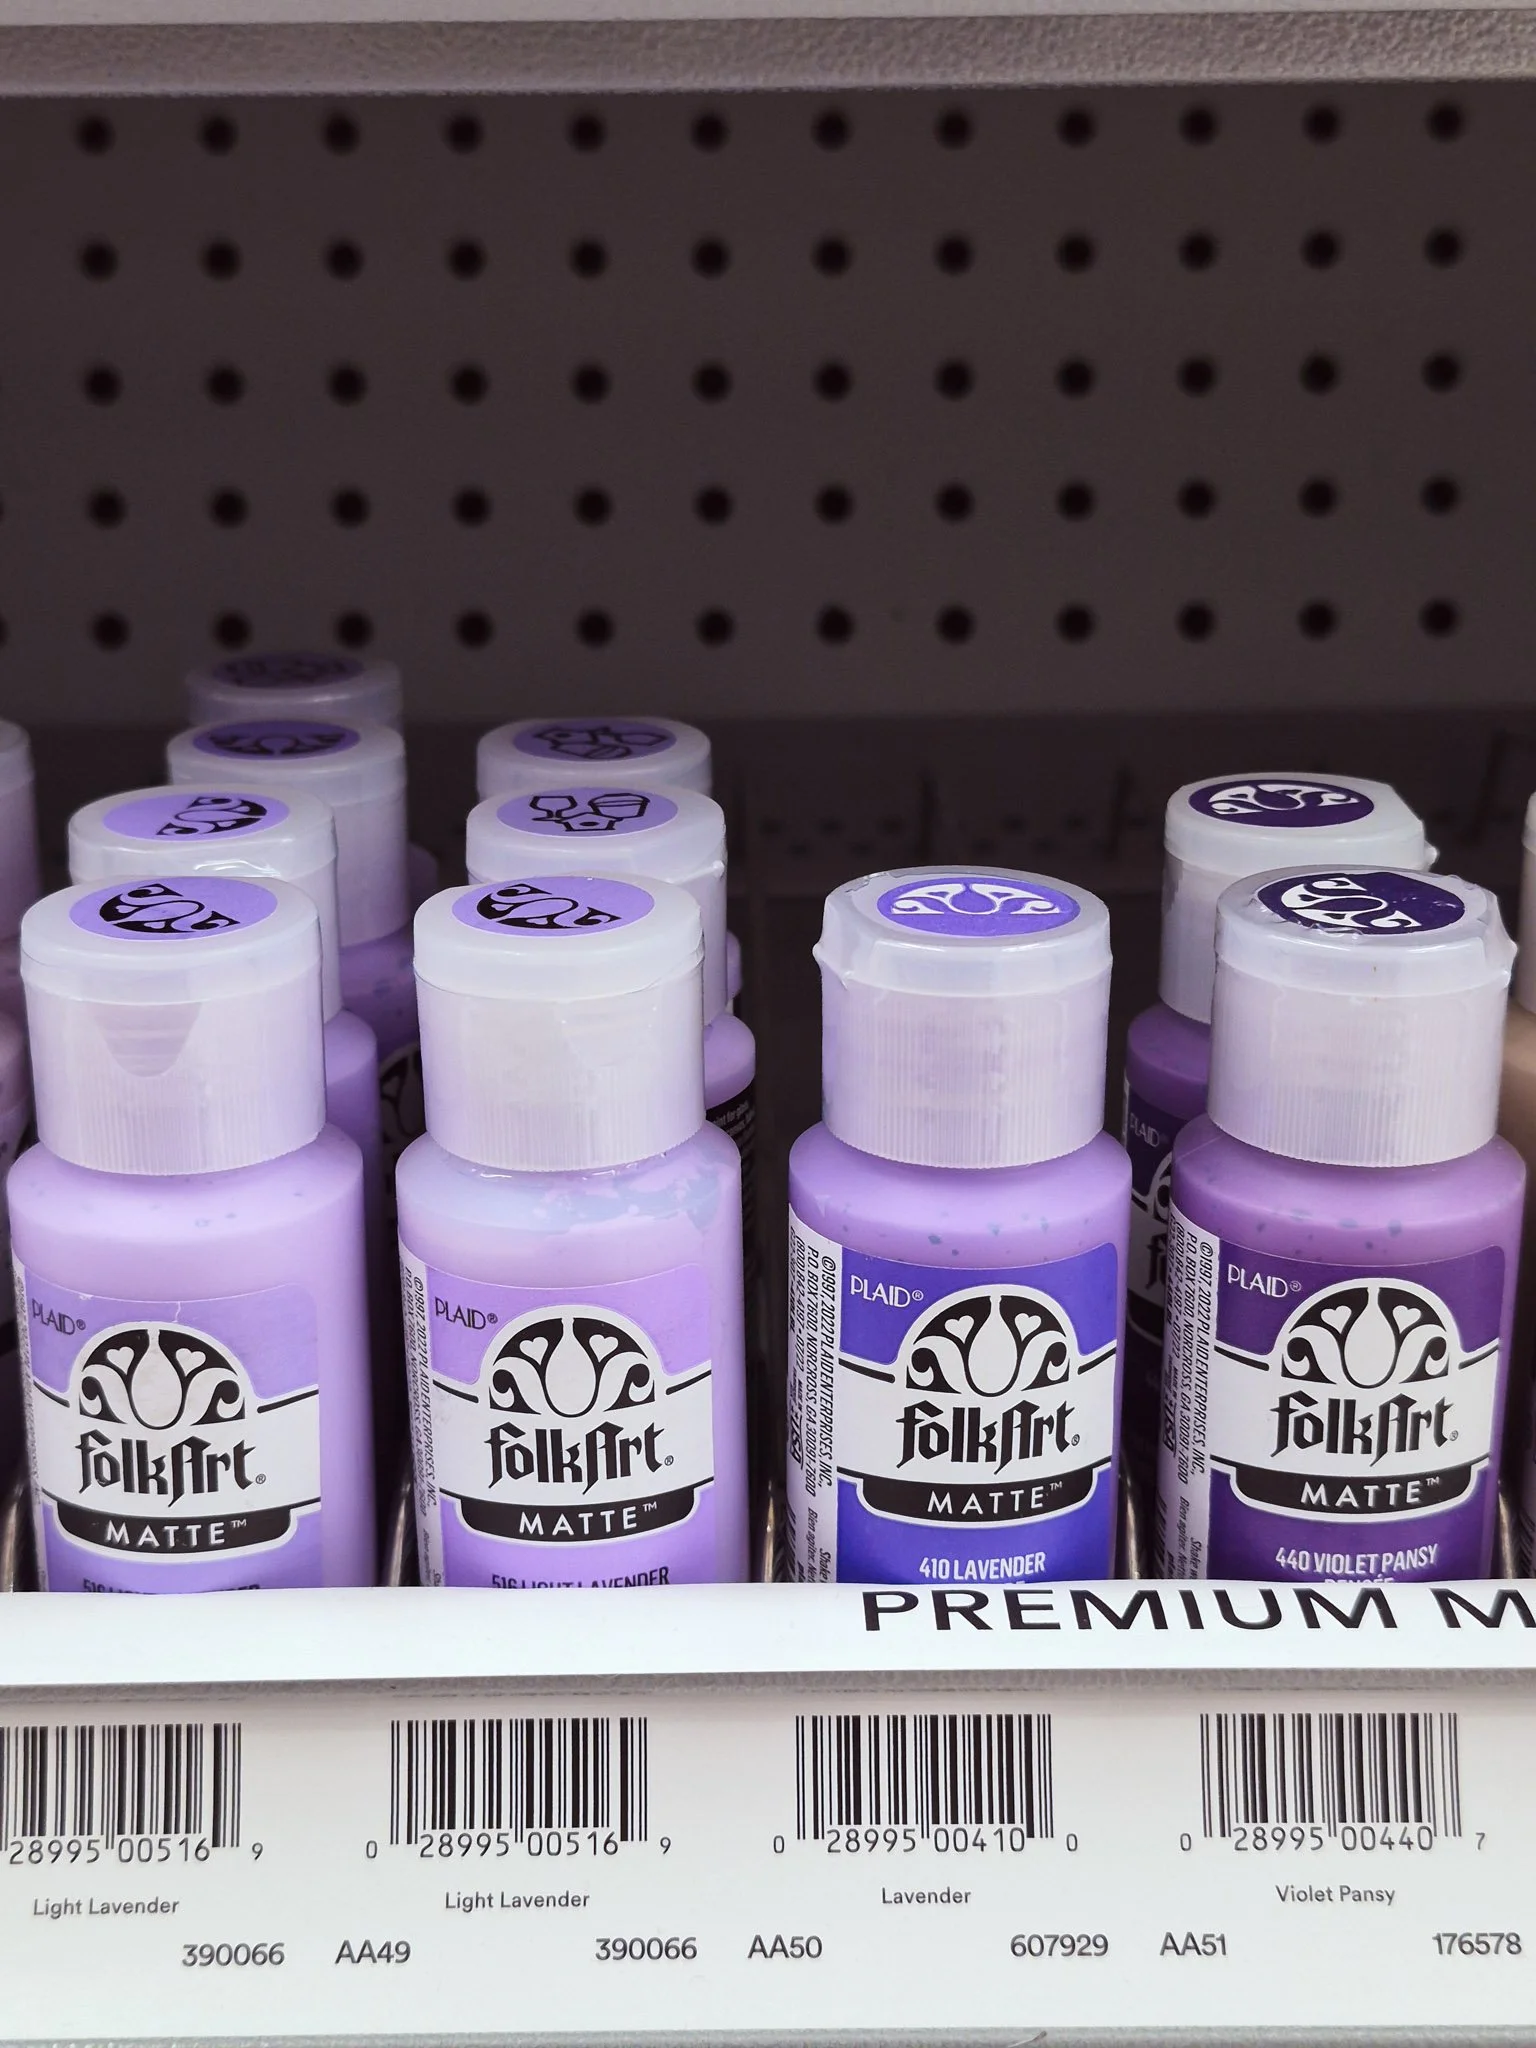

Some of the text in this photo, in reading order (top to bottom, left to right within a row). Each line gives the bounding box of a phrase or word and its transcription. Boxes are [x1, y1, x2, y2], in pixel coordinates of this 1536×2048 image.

[821, 1300, 835, 1334] 2022
[919, 1551, 1046, 1580] 410 LAVENDER
[1275, 1543, 1438, 1574] 440 VIOLET PANSY
[864, 1589, 1398, 1631] PREMIUM
[9, 1838, 263, 1864] 28995 00516 9
[366, 1832, 671, 1858] 0 28995 00516 9
[774, 1828, 1077, 1853] 0 28995 00410 0
[1180, 1826, 1485, 1851] 0 28995 00440 7
[33, 1897, 179, 1919] Light Lavender
[445, 1891, 589, 1913] Light Lavender
[882, 1887, 970, 1904] Lavender
[1276, 1885, 1395, 1906] Violet Pansy
[183, 1943, 284, 1966] 390066
[335, 1937, 697, 1964] AA49 390066
[748, 1934, 1108, 1958] AA50 607929
[1160, 1932, 1521, 1956] AA51 176578
